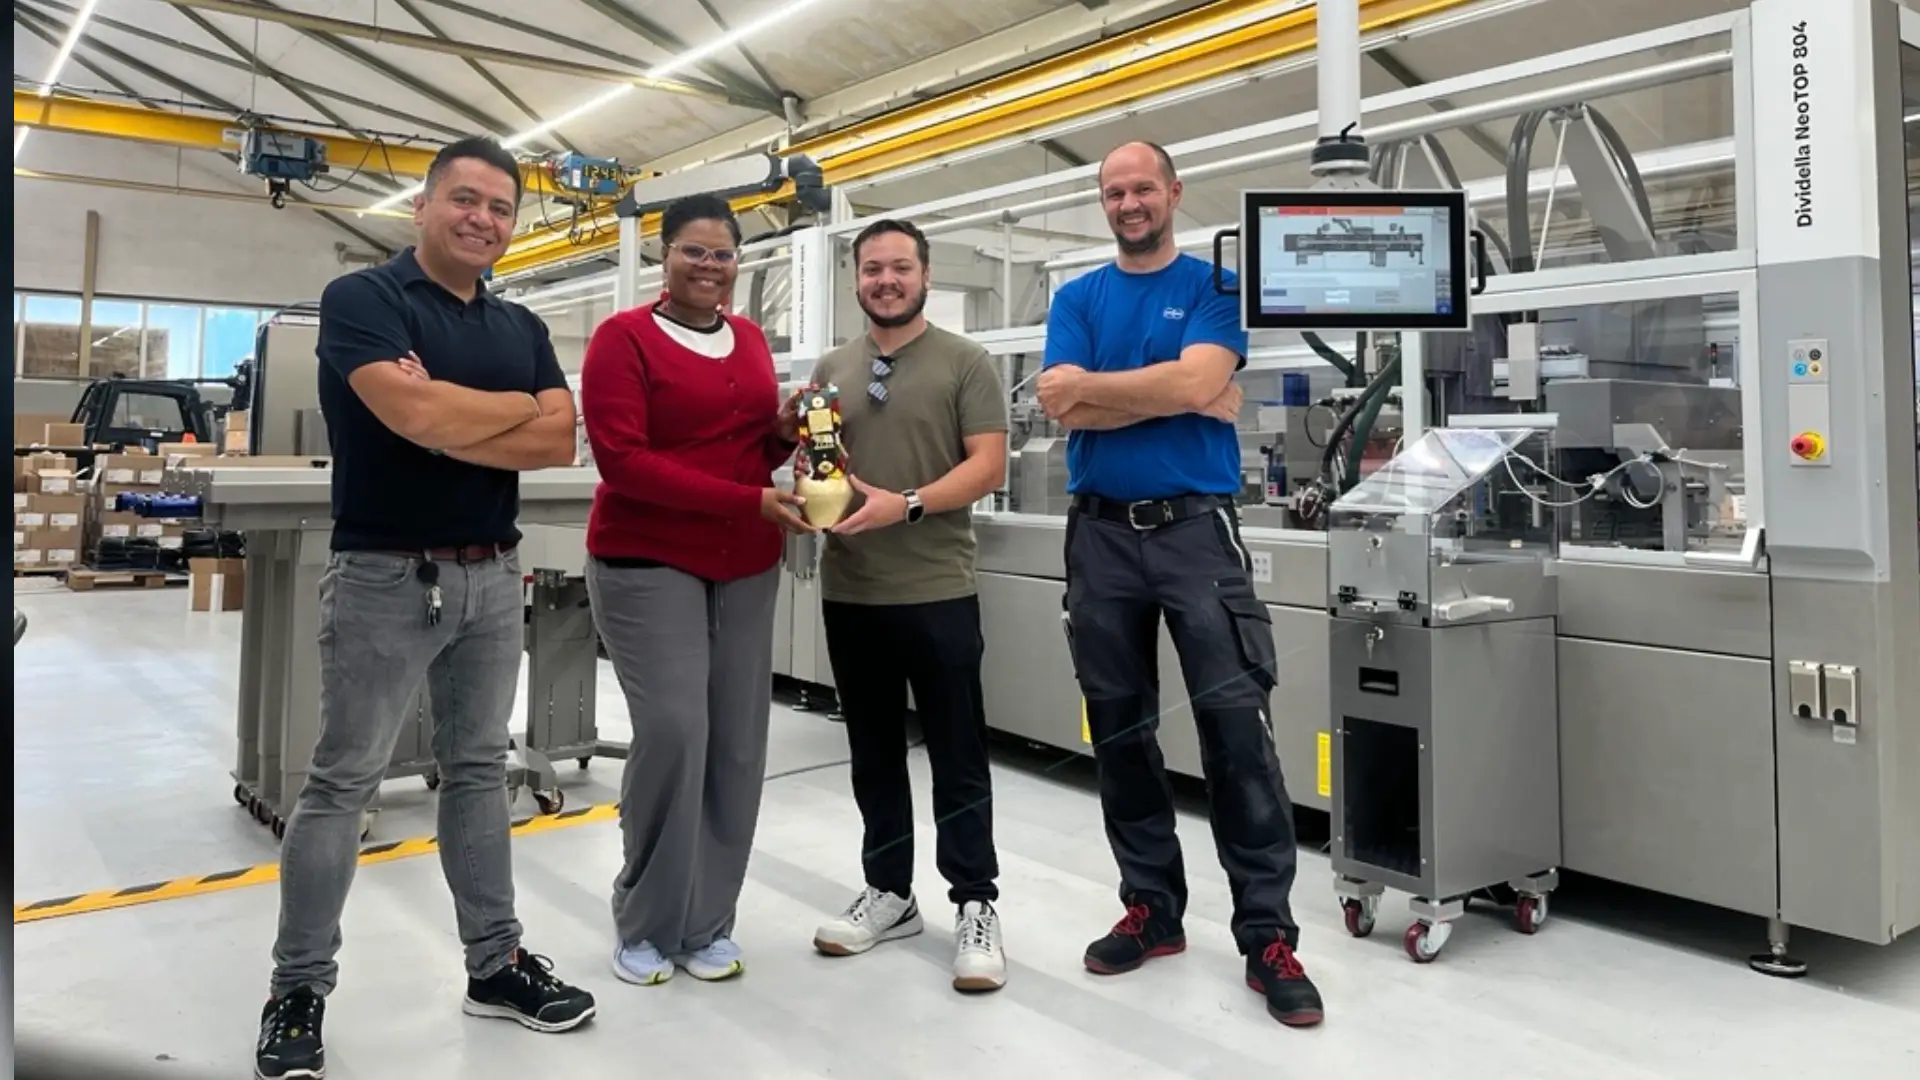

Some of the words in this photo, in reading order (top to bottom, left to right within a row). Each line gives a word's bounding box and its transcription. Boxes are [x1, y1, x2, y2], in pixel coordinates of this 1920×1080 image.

[1793, 21, 1808, 58] 804
[1793, 64, 1809, 140] NeoTOP
[1794, 145, 1812, 227] Dividella
